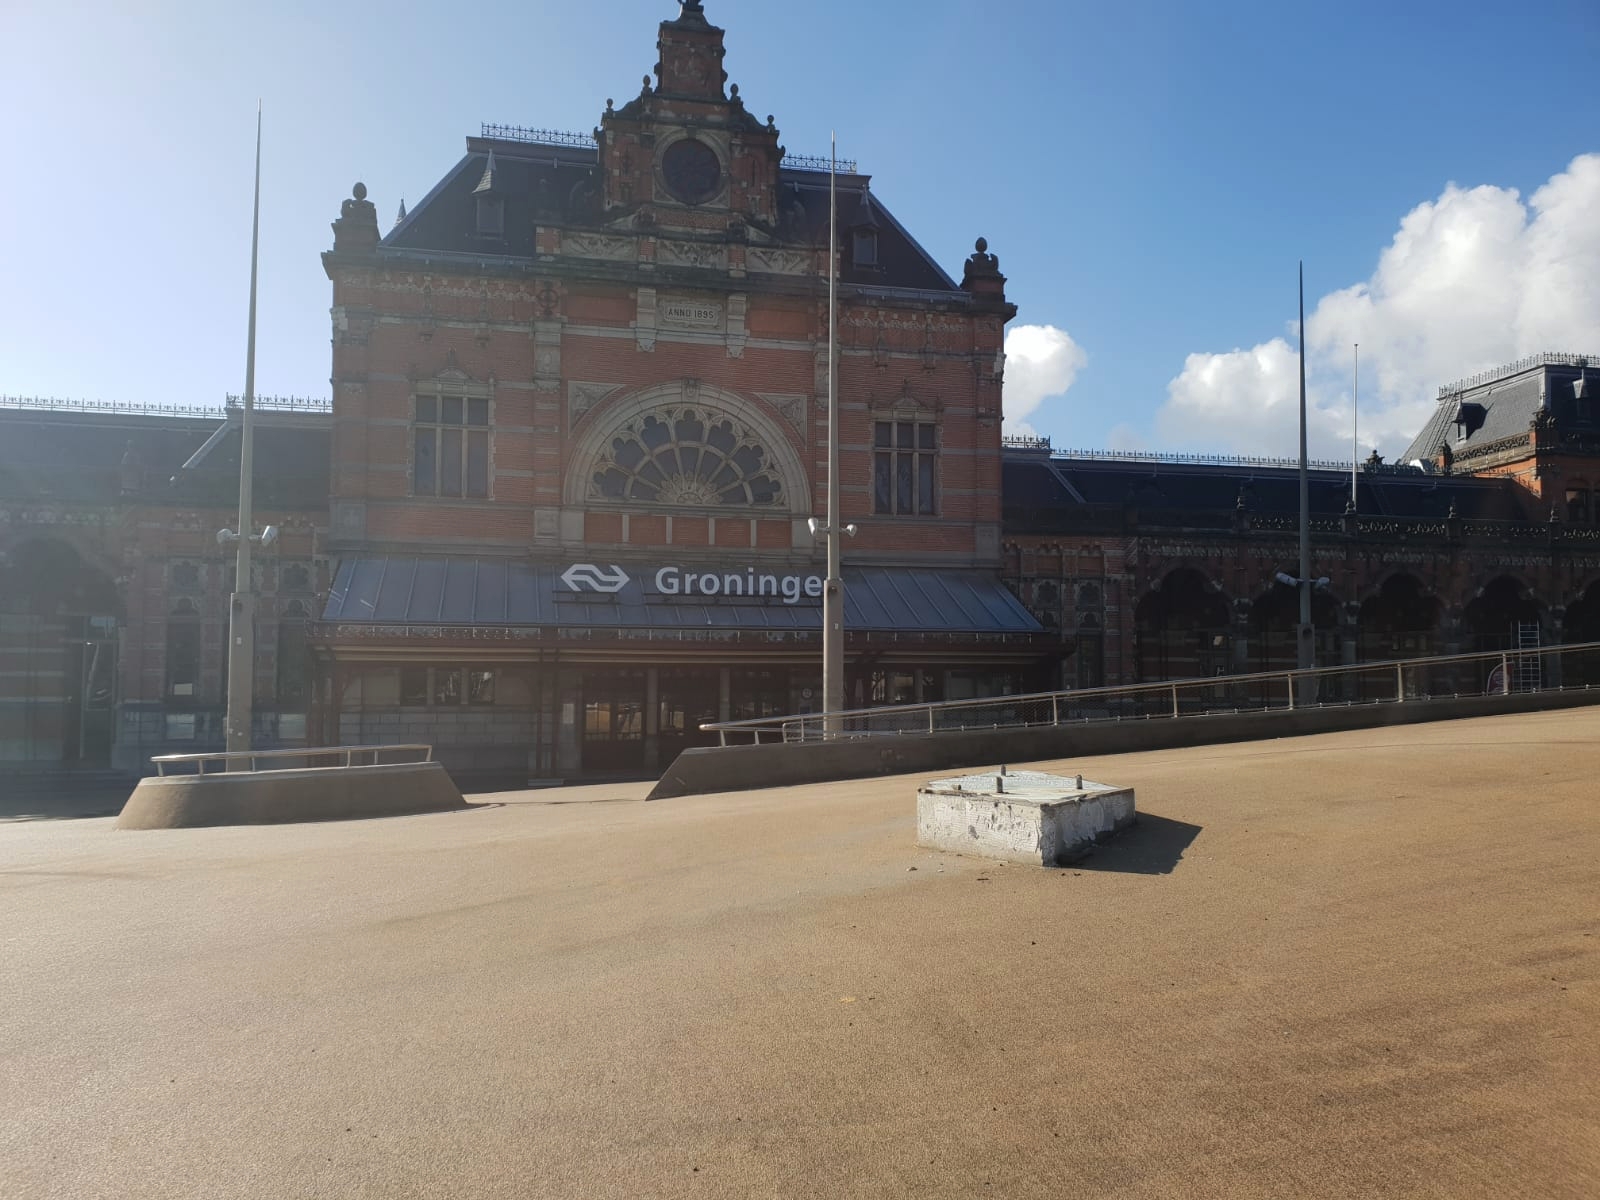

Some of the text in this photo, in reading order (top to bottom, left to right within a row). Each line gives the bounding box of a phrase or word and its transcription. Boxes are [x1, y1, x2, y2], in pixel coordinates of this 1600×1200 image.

[668, 308, 714, 319] ANNO 1895
[655, 566, 823, 605] Groninge
